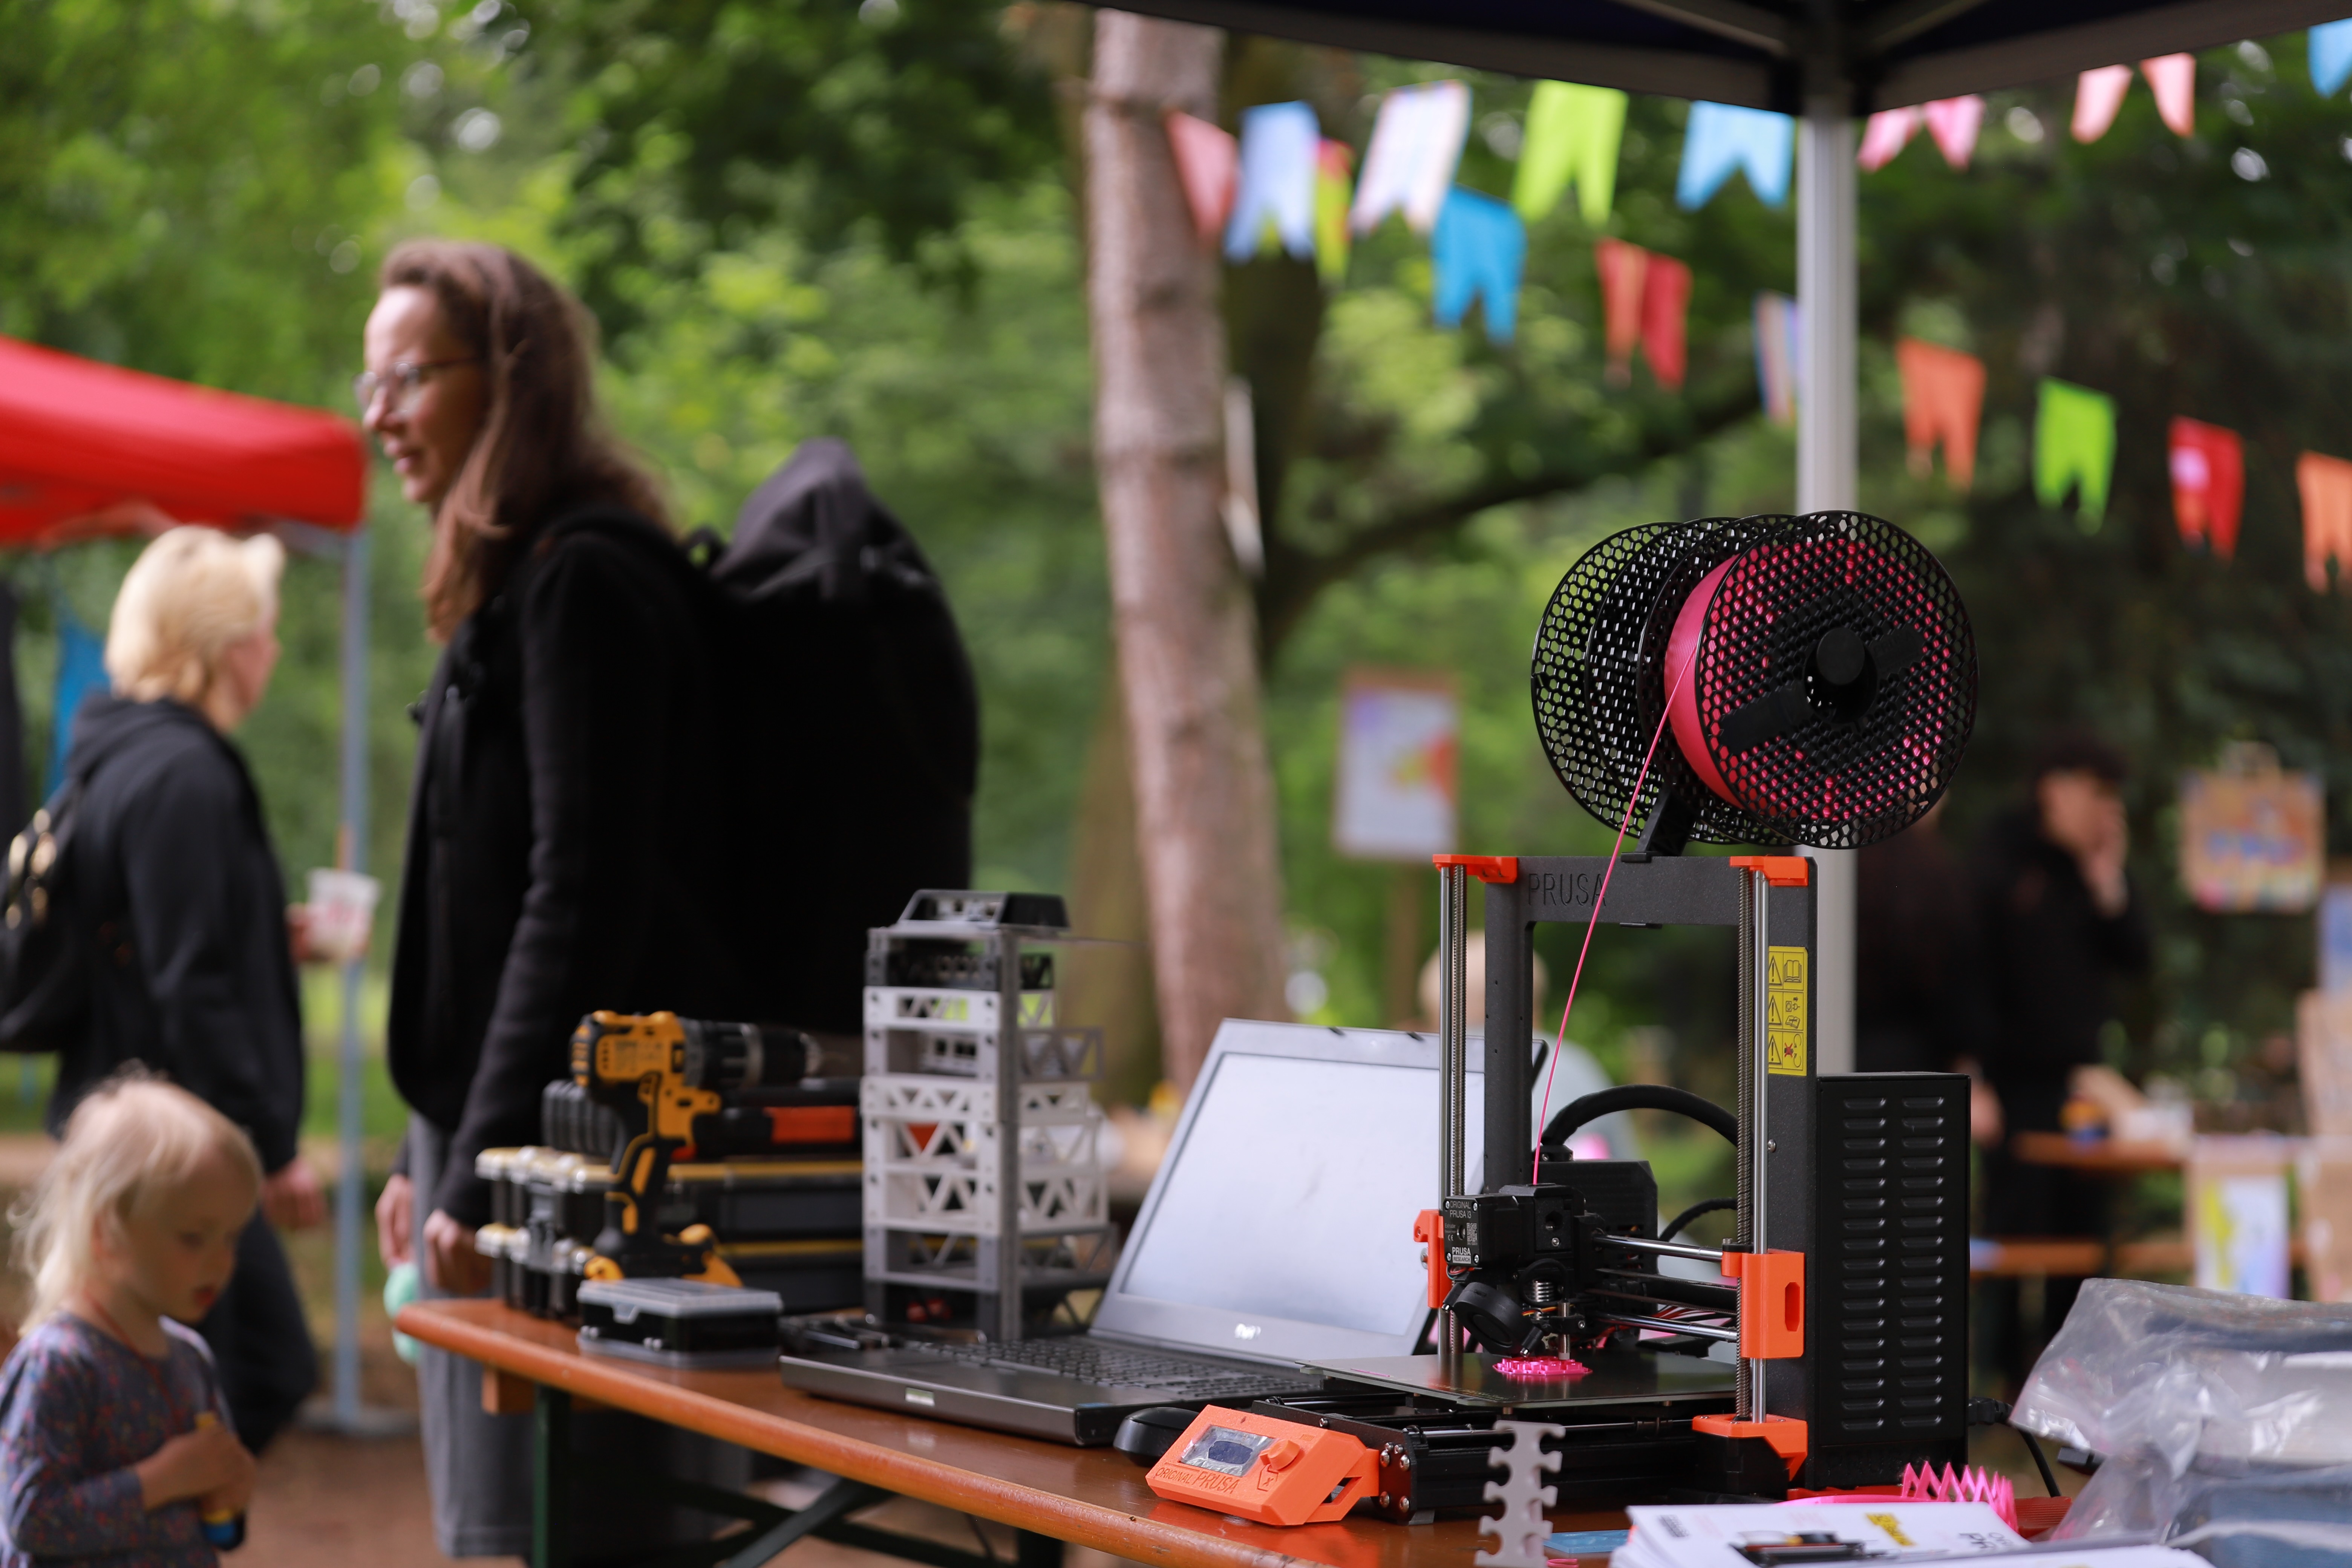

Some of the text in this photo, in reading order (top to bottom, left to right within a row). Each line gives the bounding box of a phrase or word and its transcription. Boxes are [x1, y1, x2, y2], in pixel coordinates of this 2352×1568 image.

[1528, 873, 1606, 906] PRUSA
[1450, 1200, 1471, 1209] ORIGINAL
[1450, 1210, 1467, 1218] PRUSA
[1452, 1246, 1471, 1255] PRUSA
[1155, 1467, 1240, 1494] ORIGINAL PRUSA
